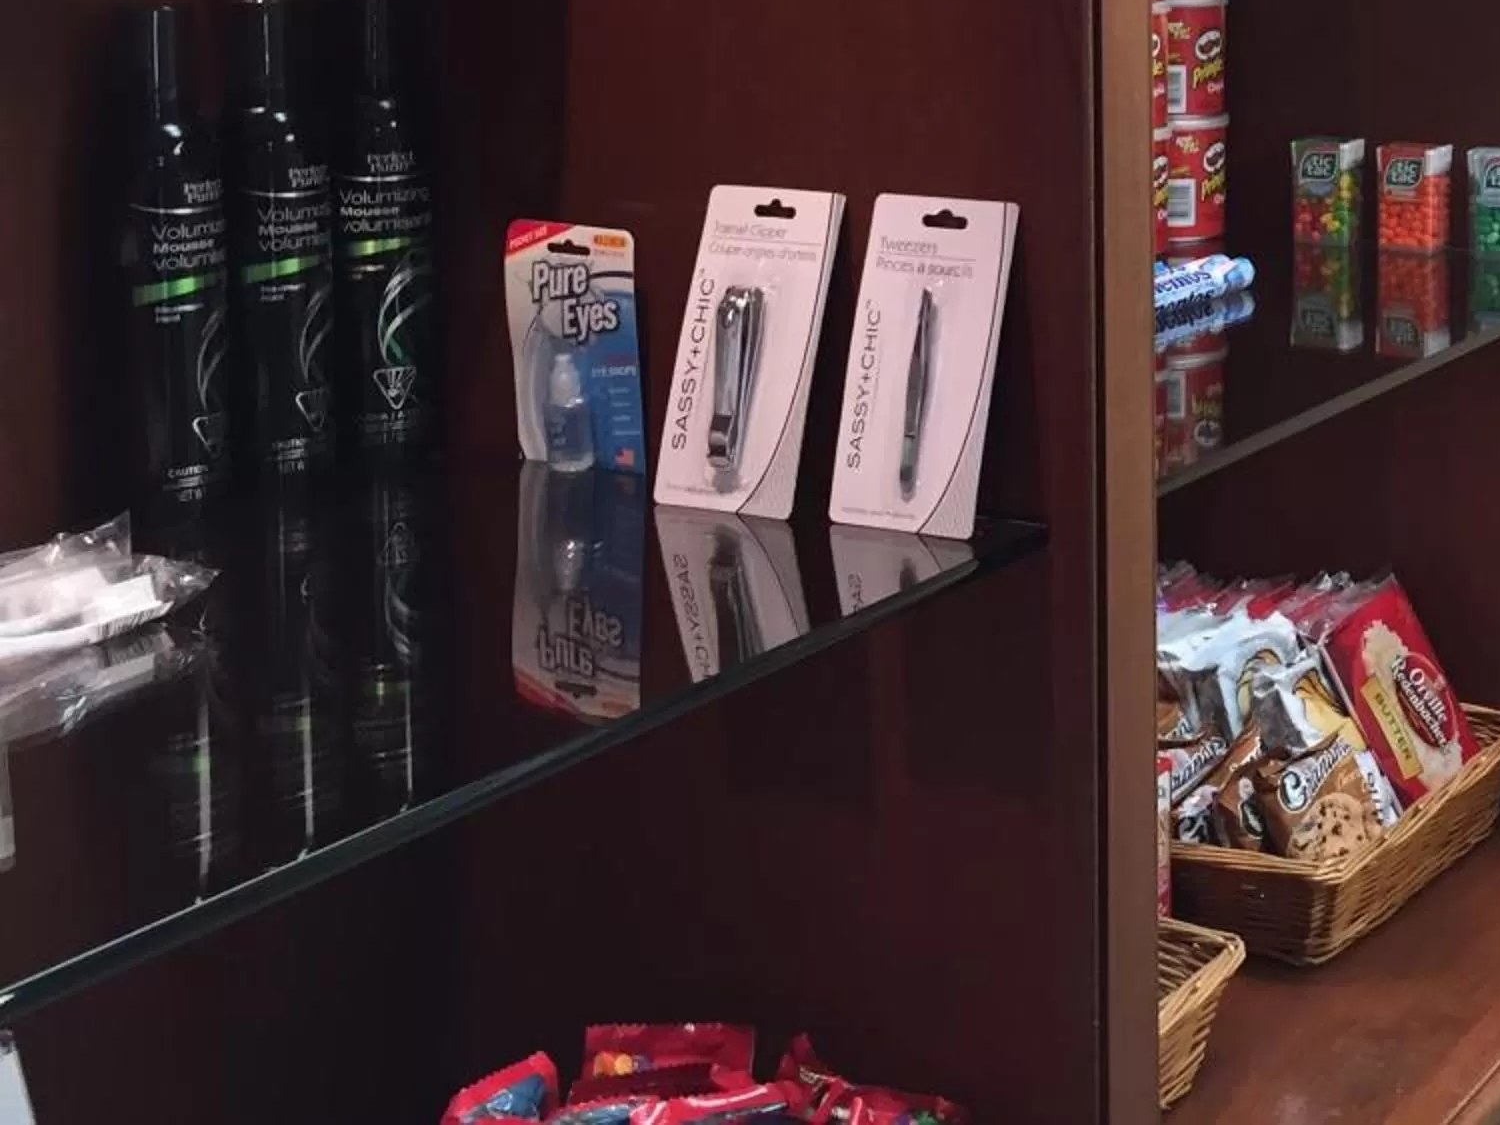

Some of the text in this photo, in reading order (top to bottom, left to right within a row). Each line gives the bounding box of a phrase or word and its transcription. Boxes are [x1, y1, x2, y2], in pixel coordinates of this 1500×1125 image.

[532, 261, 588, 301] Pure
[562, 299, 620, 344] Eyes
[671, 278, 716, 451] SASSY+CHIC
[847, 308, 882, 470] SASSY+CHIC
[1409, 667, 1449, 722] Orville
[1374, 694, 1413, 761] BUTTER
